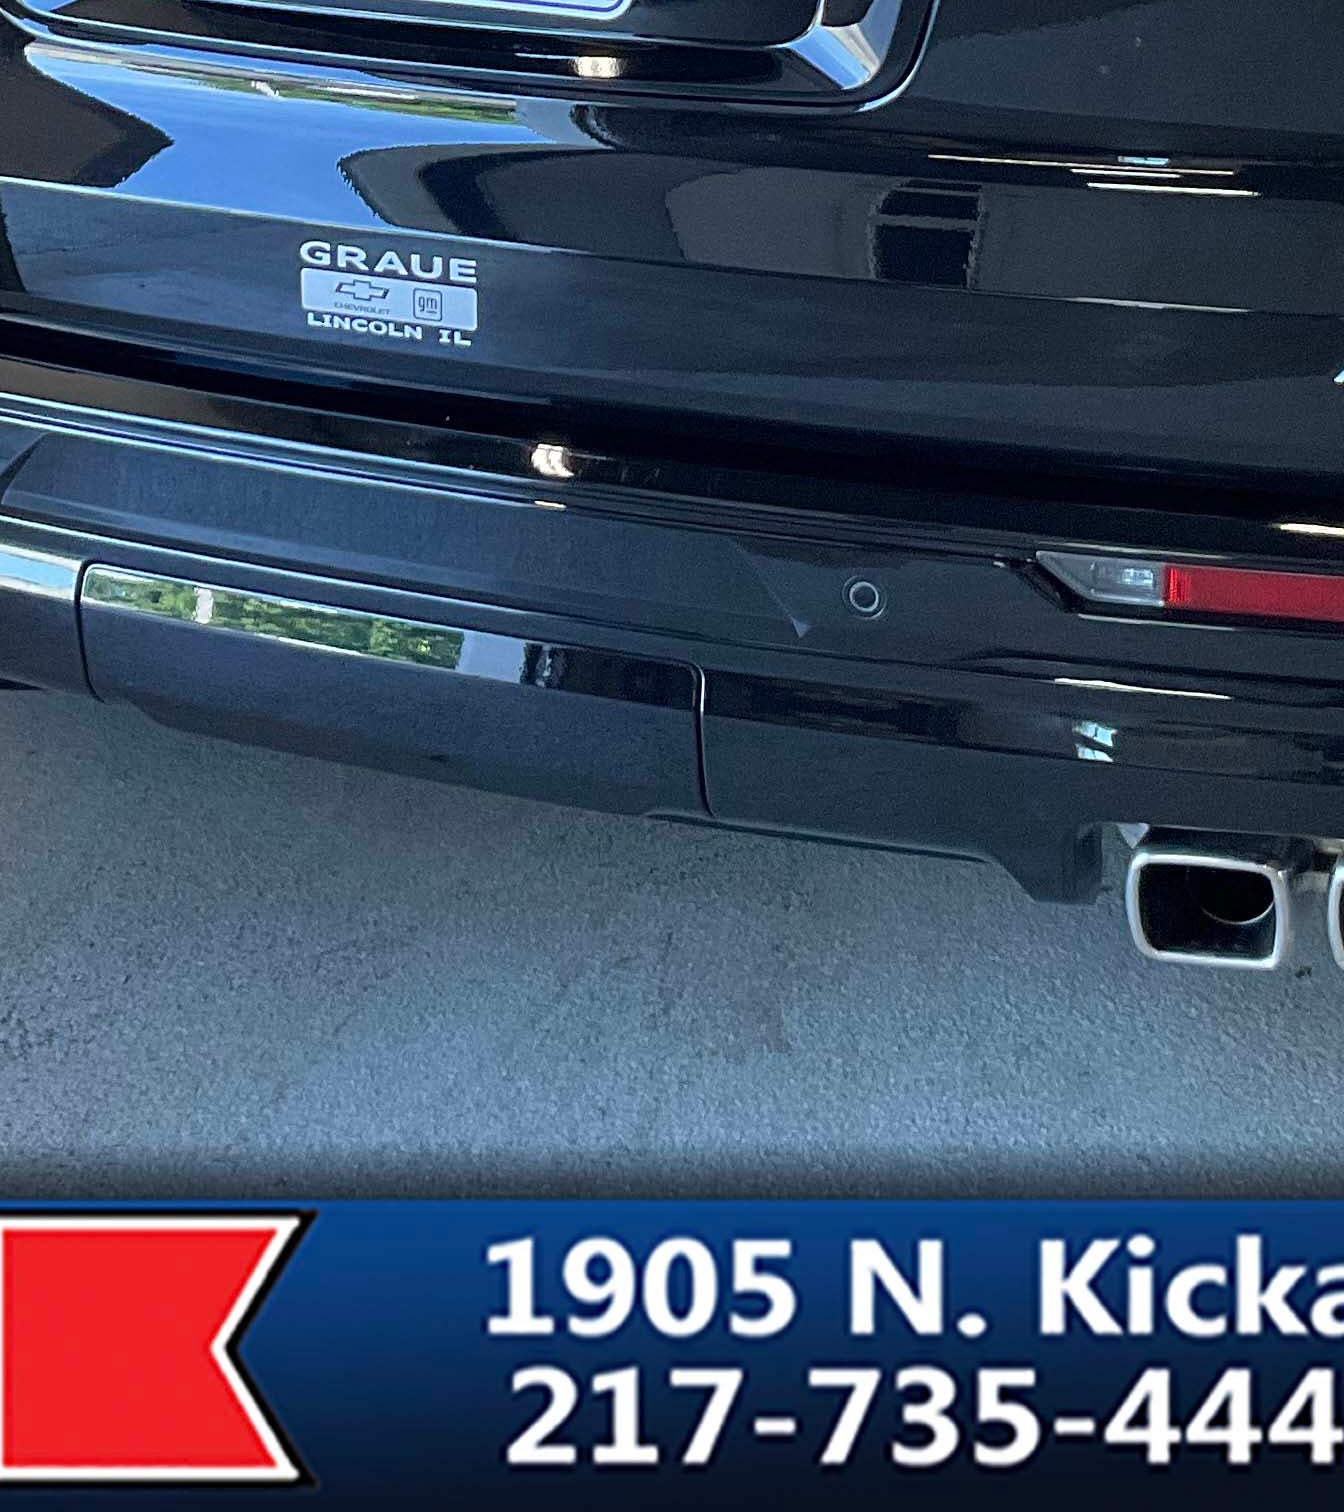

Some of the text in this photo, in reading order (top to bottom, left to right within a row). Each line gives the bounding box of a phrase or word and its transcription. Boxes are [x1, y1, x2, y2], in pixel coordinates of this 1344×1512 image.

[299, 240, 478, 284] GRAUE
[333, 301, 392, 316] CHEVROLET
[307, 312, 472, 347] LINCOLN IL
